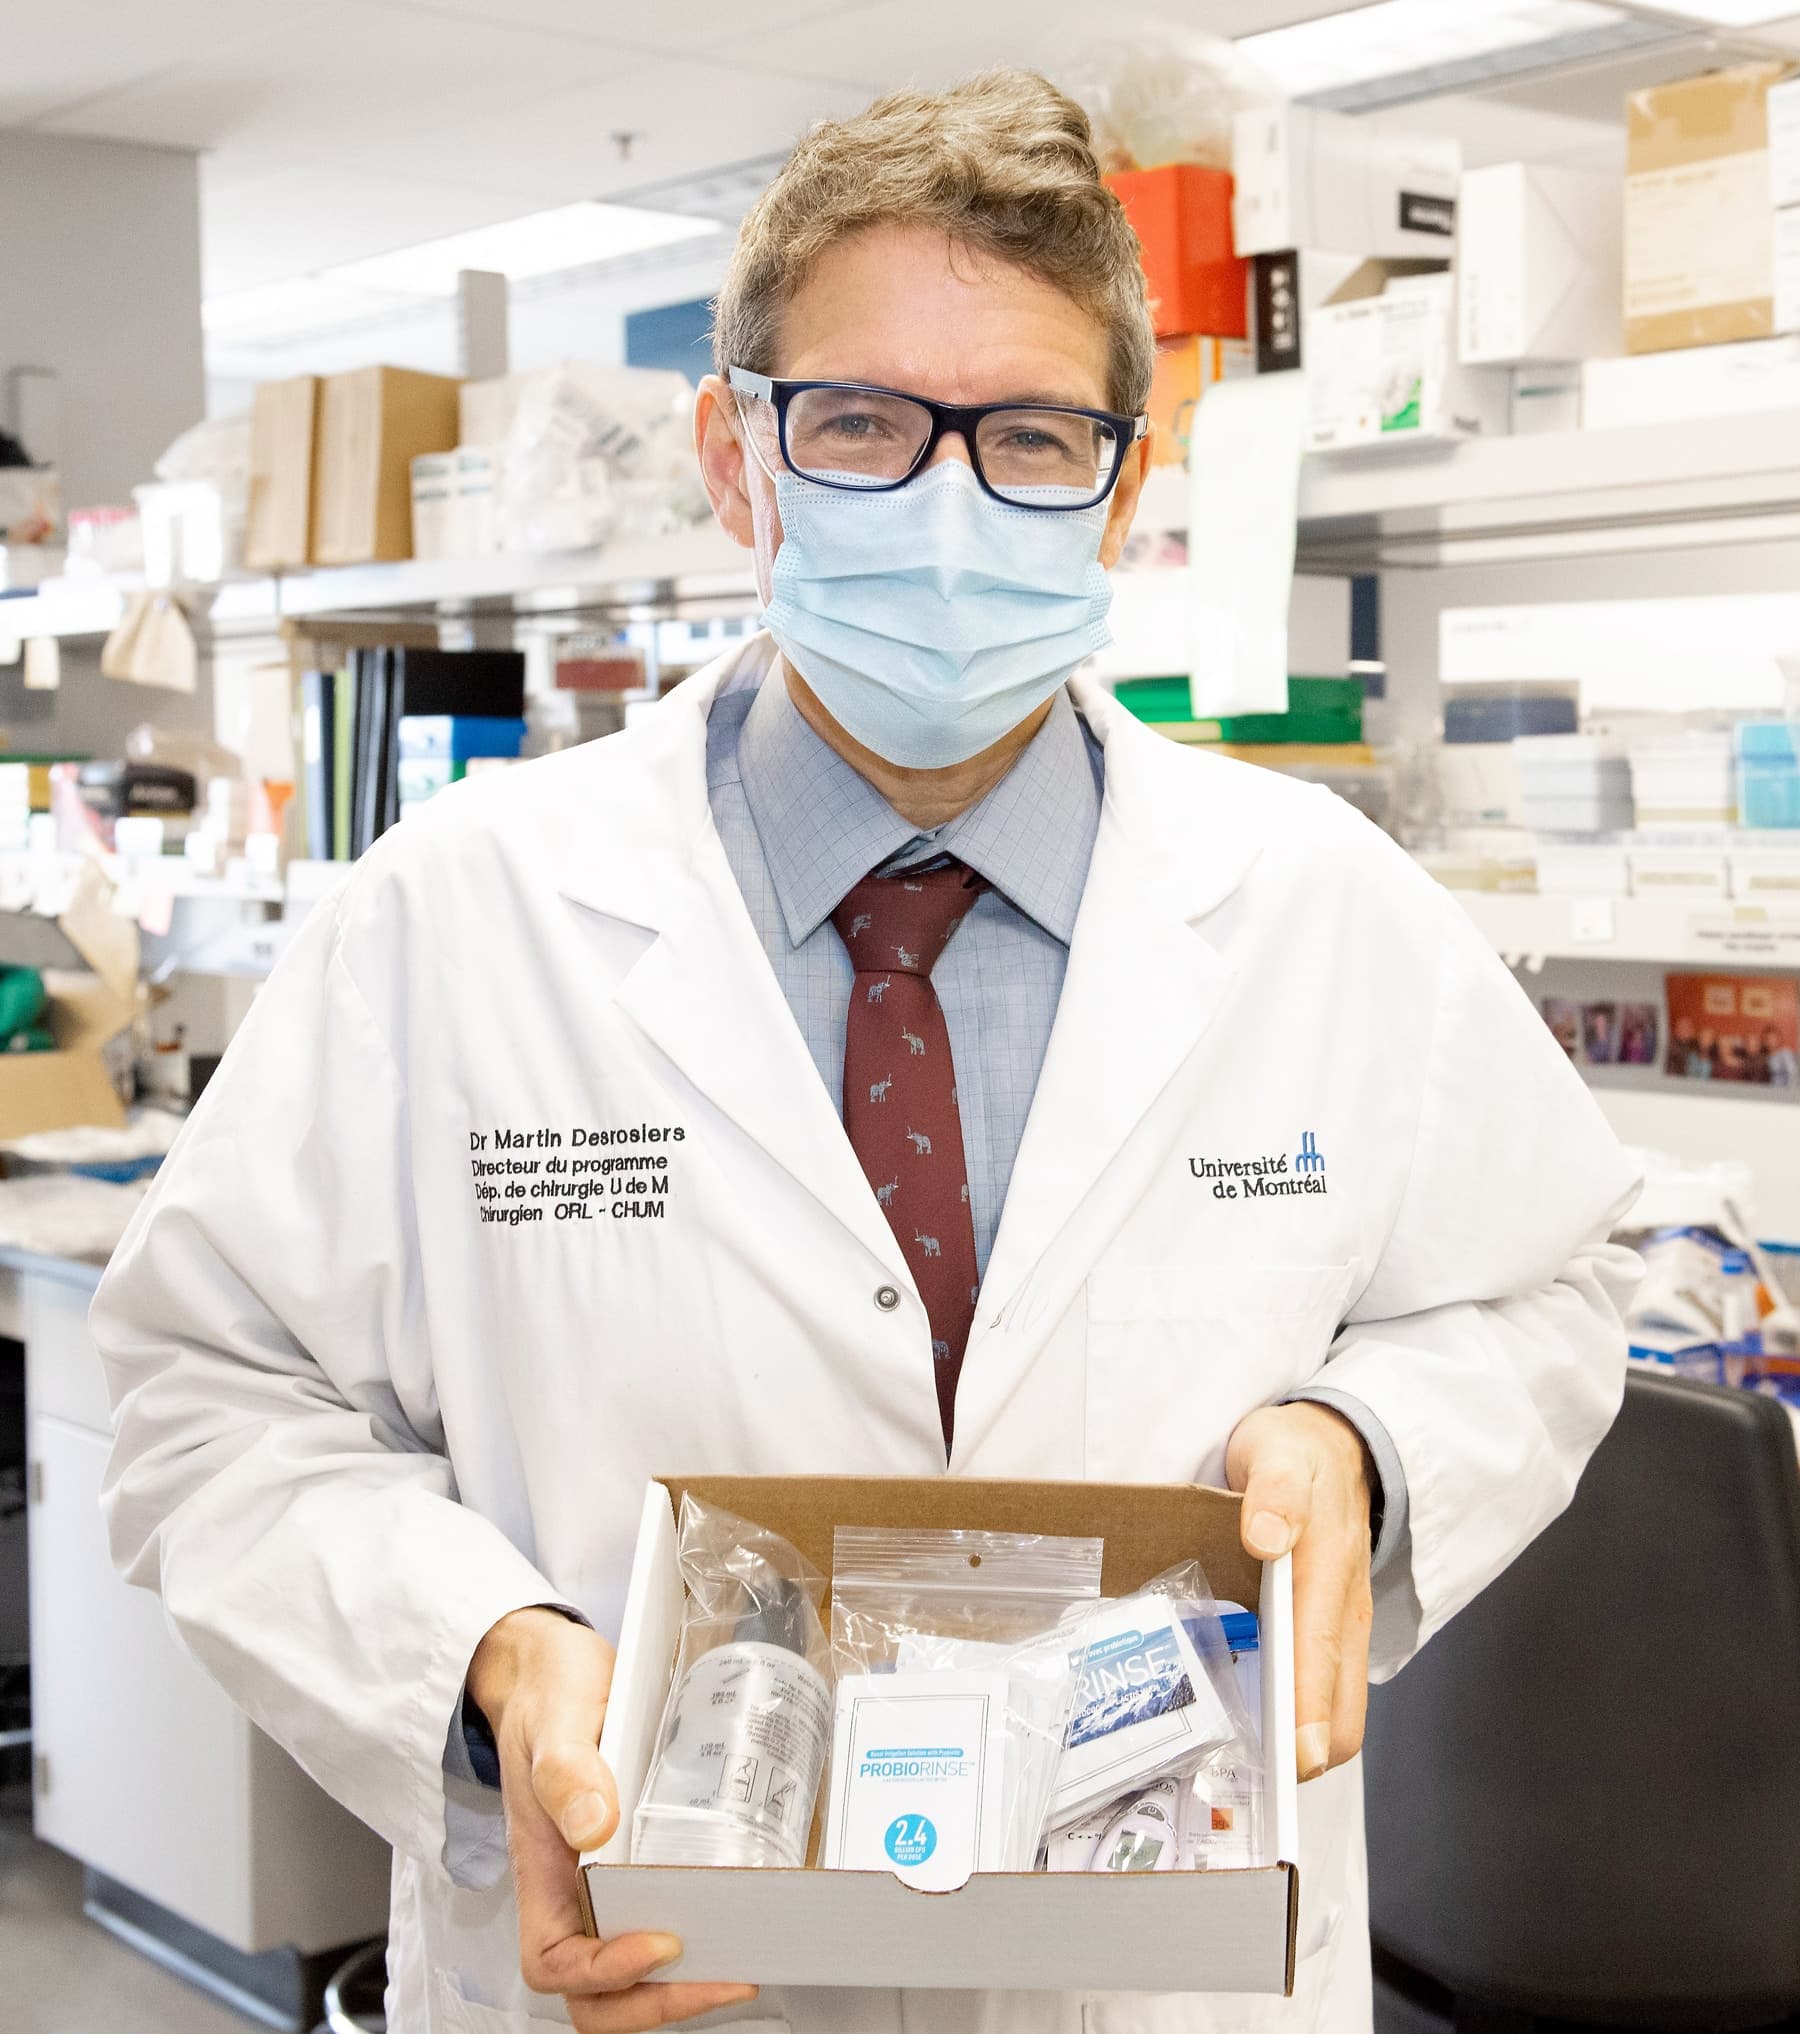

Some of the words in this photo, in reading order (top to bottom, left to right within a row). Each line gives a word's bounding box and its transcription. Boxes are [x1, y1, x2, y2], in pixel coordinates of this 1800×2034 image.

[470, 1132, 487, 1151] Dr
[495, 1128, 562, 1150] Martin
[572, 1123, 686, 1148] Desrosiers
[471, 1158, 541, 1177] Directeur
[545, 1156, 568, 1174] du
[572, 1155, 668, 1176] programme
[1188, 1153, 1288, 1178] Université
[475, 1180, 501, 1202] Dép.
[504, 1180, 526, 1199] de
[530, 1178, 604, 1201] chirurgie
[610, 1177, 623, 1196] U
[625, 1176, 648, 1195] de
[651, 1175, 669, 1195] M
[1212, 1181, 1237, 1199] de
[1242, 1173, 1328, 1198] Montréal
[480, 1203, 543, 1226] Chirurgien
[554, 1202, 593, 1220] ORL
[611, 1200, 665, 1219] CHUM
[895, 1819, 928, 1846] 2.4
